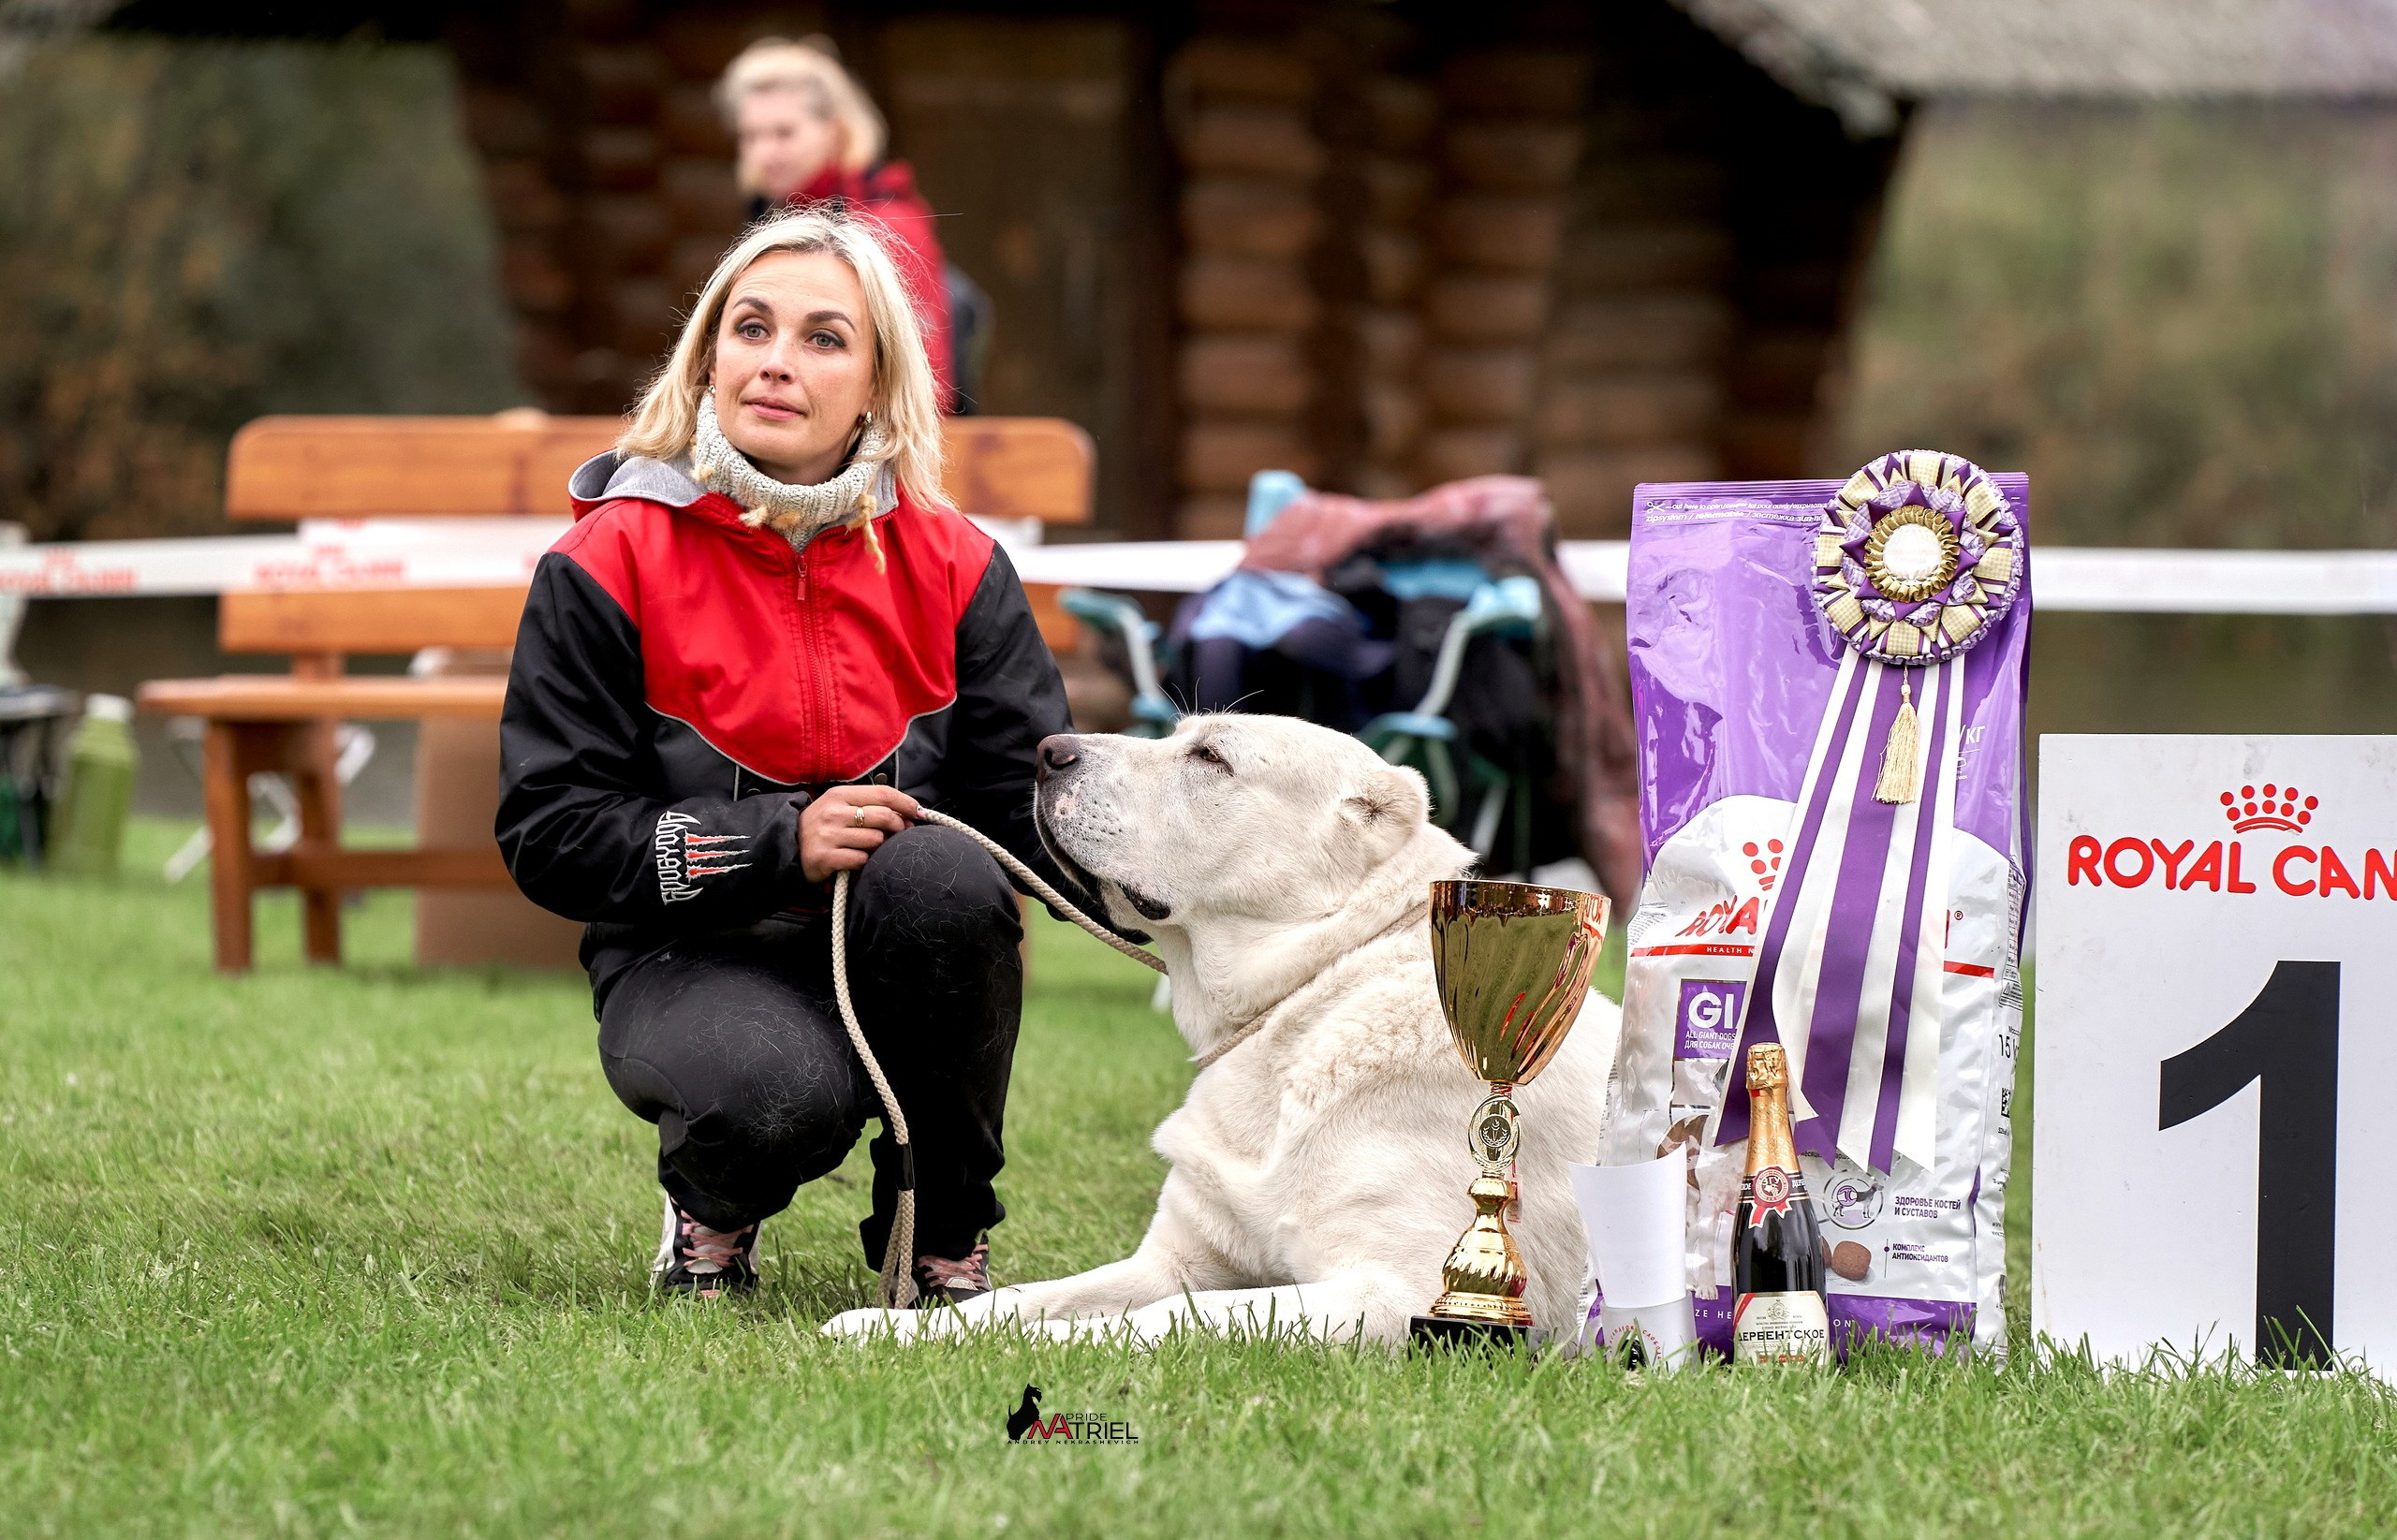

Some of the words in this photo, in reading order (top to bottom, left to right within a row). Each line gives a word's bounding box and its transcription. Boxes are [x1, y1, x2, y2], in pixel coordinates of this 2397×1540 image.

[2067, 834, 2257, 894] ROYAL
[2272, 844, 2397, 901] CAN
[1675, 895, 1769, 937] ROYA
[1688, 991, 1737, 1029] GI
[1685, 1031, 1698, 1039] ALL
[1698, 1032, 1719, 1040] GIANT
[1719, 1033, 1736, 1041] DOGS
[1684, 1040, 1698, 1049] ДЛЯ
[1699, 1041, 1721, 1049] СОБАК
[2158, 961, 2341, 1371] 1
[1895, 1195, 1933, 1208] ЗДОРОВЬЕ
[1934, 1199, 1962, 1210] КОСТЕЙ
[1894, 1207, 1900, 1216] И
[1902, 1207, 1938, 1219] СУСТАВОВ
[1892, 1243, 1925, 1253] КОМПЛЕКС
[1891, 1252, 1948, 1263] АНТИОКСИДАНТОВ
[1717, 1311, 1731, 1319] HE
[1833, 1319, 1851, 1328] ON
